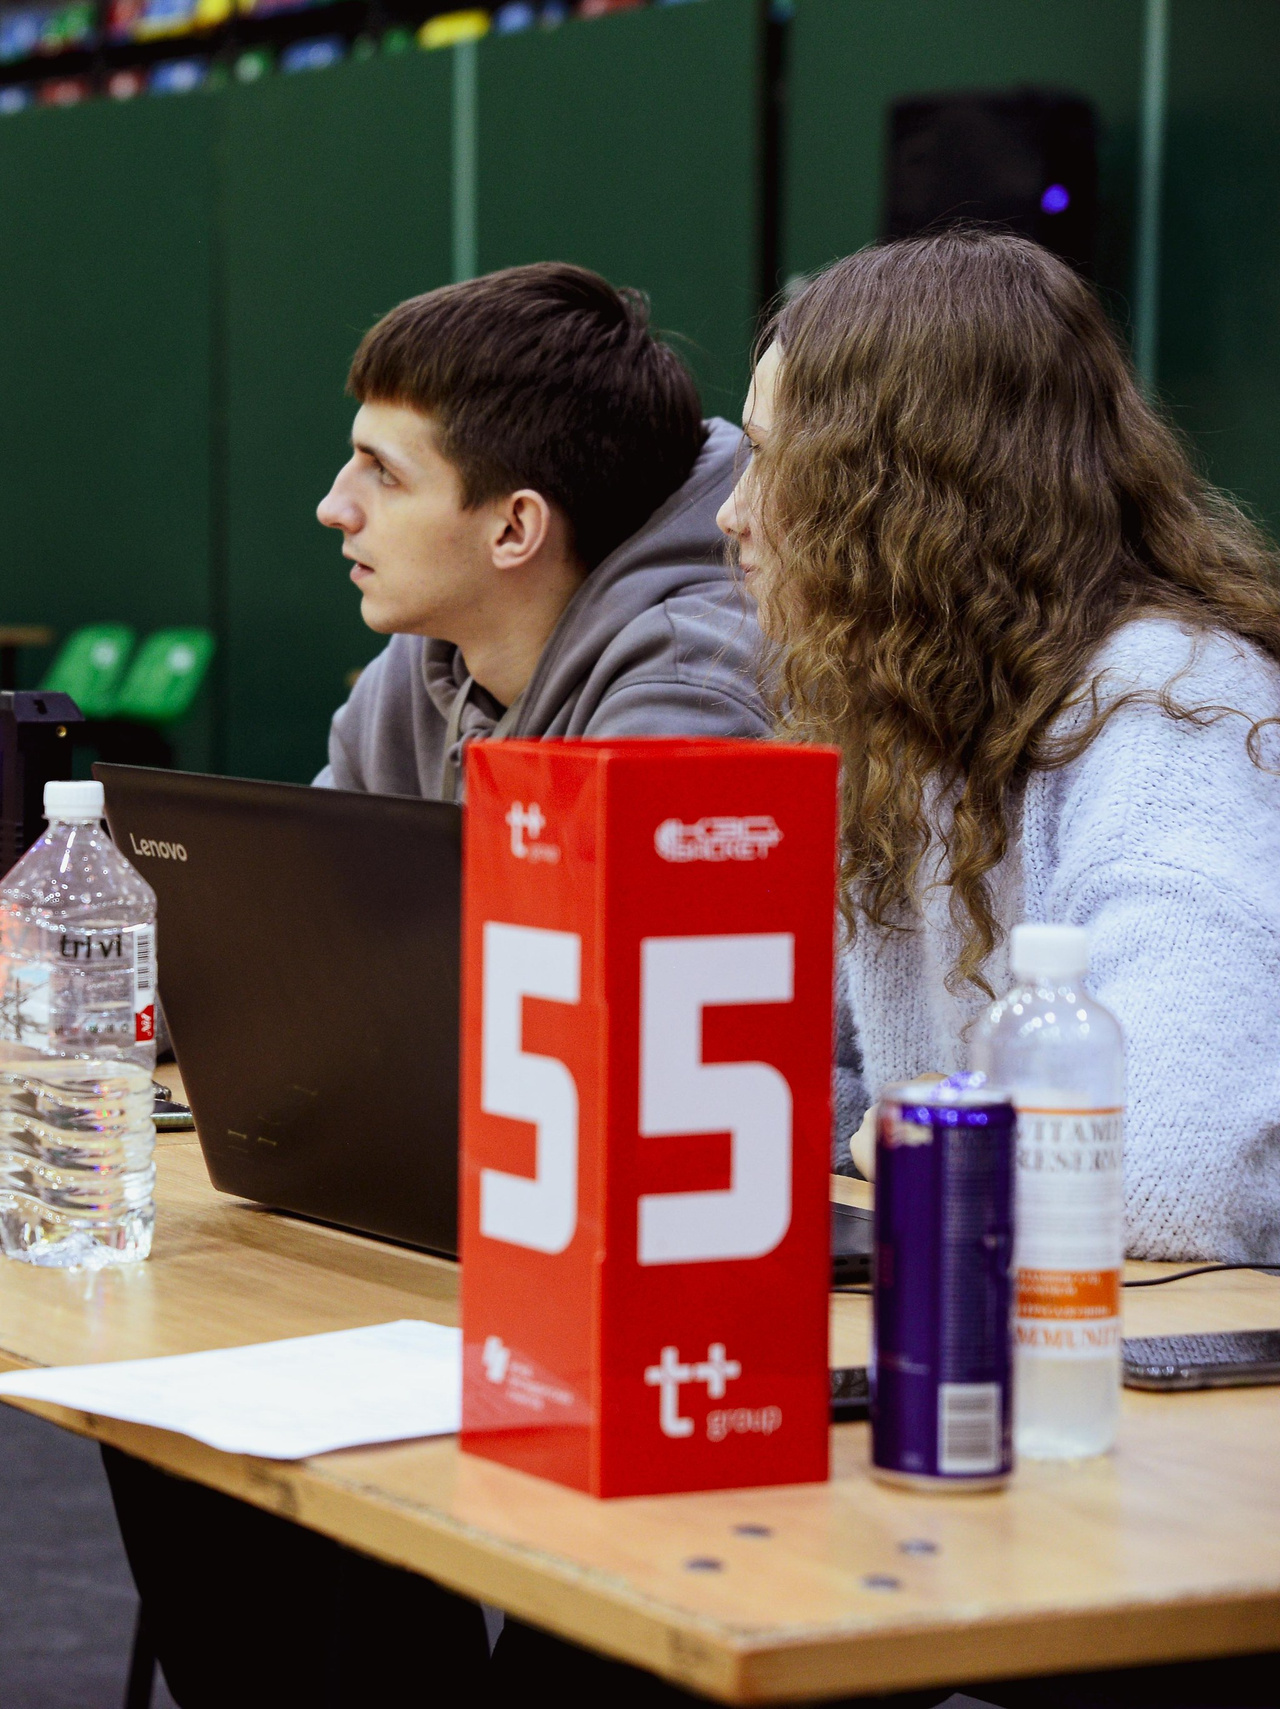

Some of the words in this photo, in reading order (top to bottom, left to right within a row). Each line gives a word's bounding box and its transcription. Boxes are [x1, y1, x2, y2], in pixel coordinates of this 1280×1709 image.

[129, 832, 188, 862] Lenovo
[479, 920, 581, 1255] 5
[637, 932, 795, 1265] 5
[1017, 1119, 1120, 1143] VITAMI
[1018, 1150, 1120, 1173] RESERV
[706, 1404, 783, 1442] group
